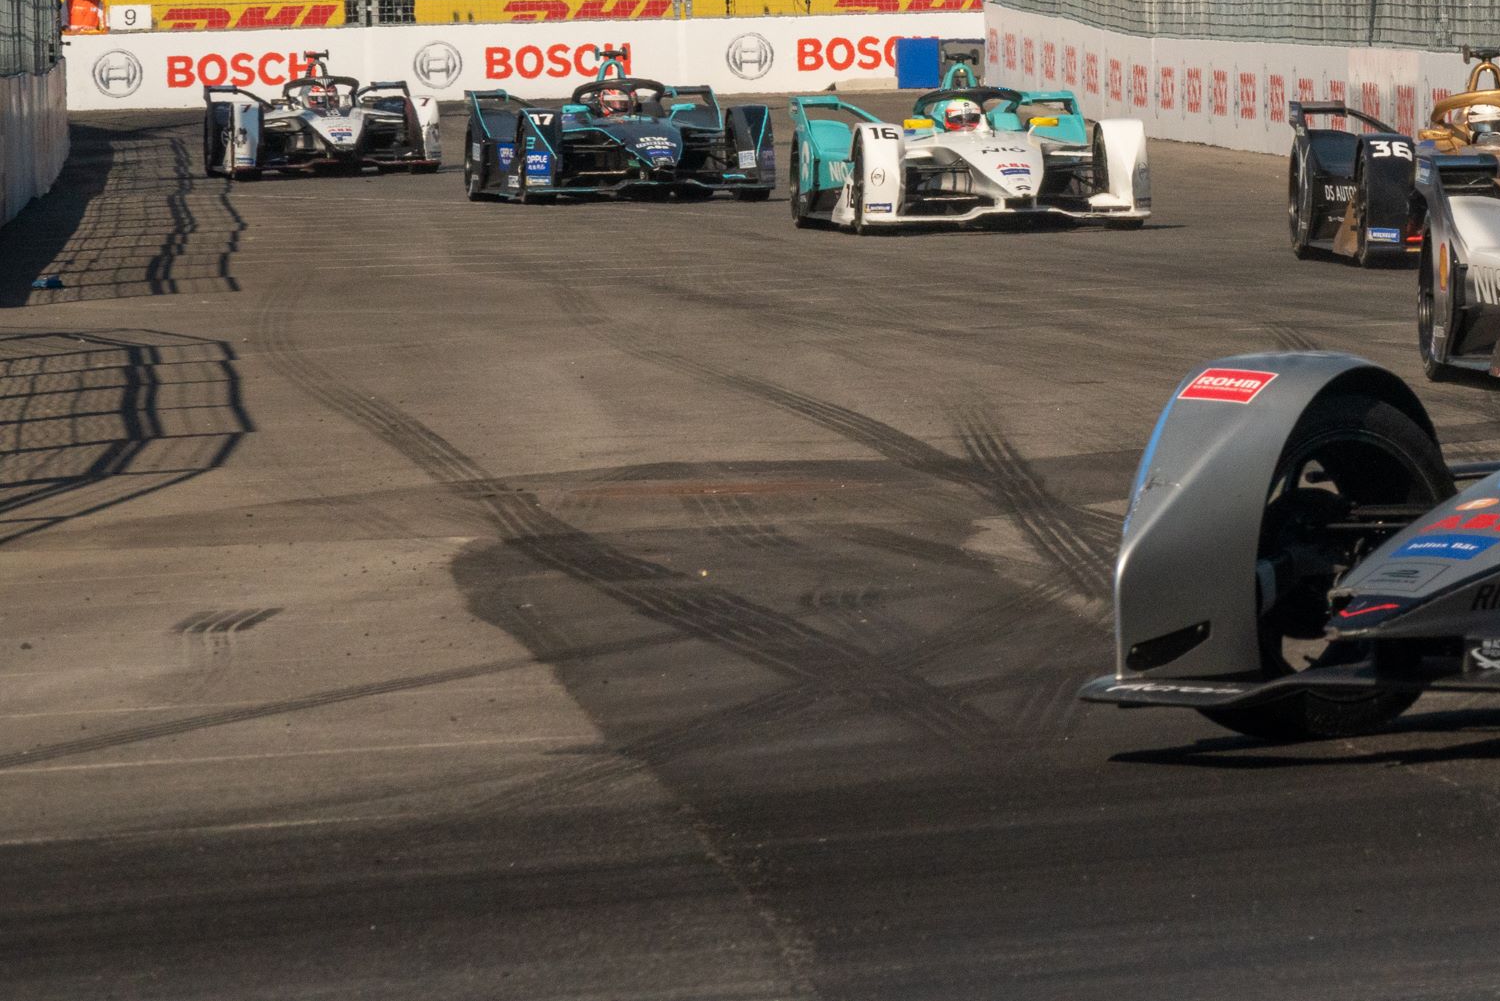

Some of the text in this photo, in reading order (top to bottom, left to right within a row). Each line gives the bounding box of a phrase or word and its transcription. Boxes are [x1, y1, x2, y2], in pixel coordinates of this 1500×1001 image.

[124, 8, 137, 26] 9
[485, 42, 632, 80] BOSCH
[868, 127, 899, 140] 16
[1369, 140, 1413, 162] 36
[1197, 375, 1262, 390] ROHM
[1407, 542, 1449, 551] Julius
